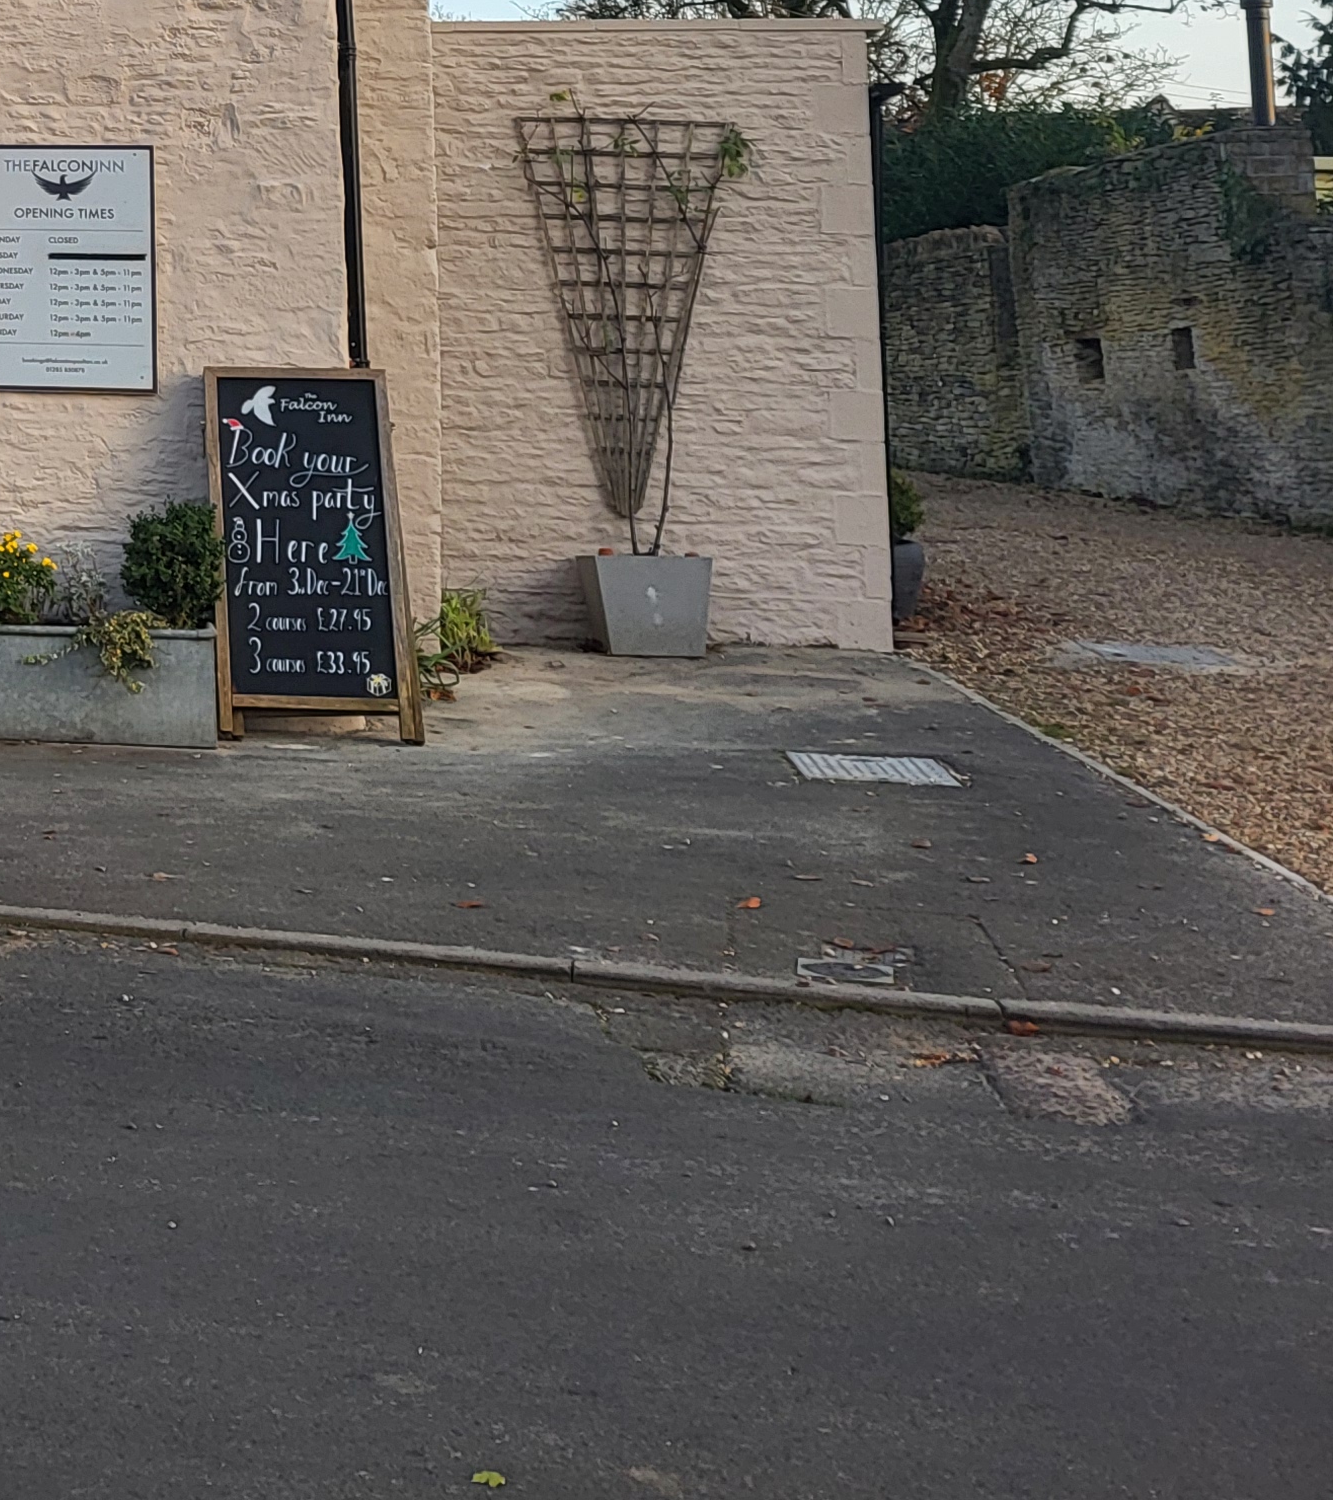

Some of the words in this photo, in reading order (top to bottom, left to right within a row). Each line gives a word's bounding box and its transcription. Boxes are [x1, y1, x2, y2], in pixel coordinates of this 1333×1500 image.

[14, 207, 74, 219] OPENING
[77, 208, 115, 220] TIMES
[49, 268, 69, 277] 12pm
[74, 268, 91, 277] 3pm
[100, 268, 116, 277] 5pm
[49, 283, 69, 292] 12pm
[74, 283, 91, 293] 3pm
[100, 284, 116, 293] 5pm
[49, 299, 69, 308] 12pm
[74, 299, 91, 308] 3pm
[100, 300, 116, 309] 5pm
[49, 314, 69, 323] 12pm
[74, 314, 91, 323] 3pm
[100, 315, 116, 324] 5pm
[50, 329, 69, 338] 12pm
[75, 330, 91, 339] 4pm
[280, 398, 337, 412] Falcon
[318, 411, 352, 423] Inn
[226, 428, 296, 468] Book
[290, 451, 369, 487] your
[228, 471, 300, 510] Xmas
[312, 478, 381, 529] party
[256, 518, 329, 564] Here
[234, 566, 277, 596] from
[367, 568, 388, 596] Dec
[247, 602, 262, 632] 2
[265, 616, 307, 632] courses
[317, 607, 372, 632] £27.95
[248, 637, 262, 674] 3
[266, 657, 306, 673] courses
[317, 651, 371, 675] £33.95
